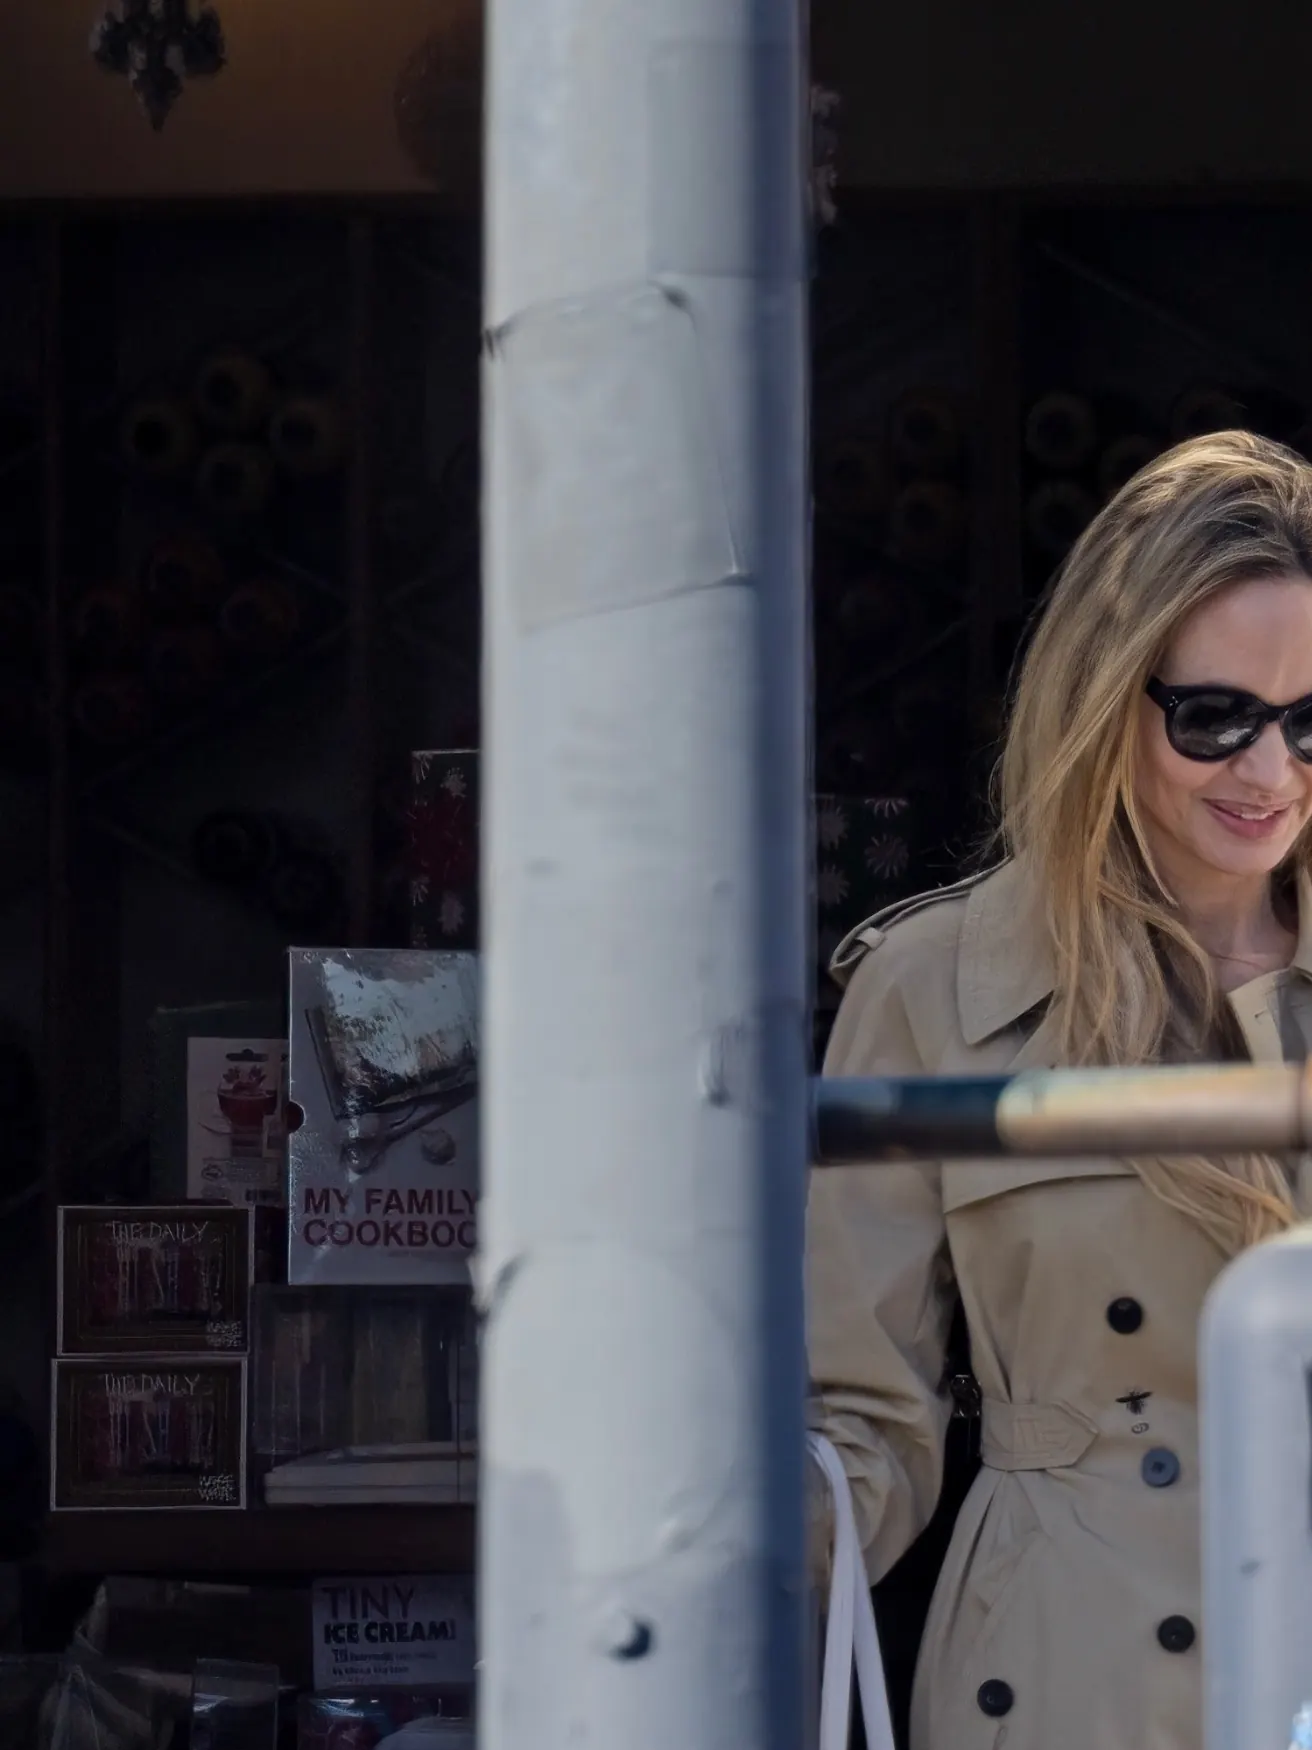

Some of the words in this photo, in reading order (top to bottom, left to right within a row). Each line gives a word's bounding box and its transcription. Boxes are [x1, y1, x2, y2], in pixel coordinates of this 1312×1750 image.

[304, 1187, 352, 1215] MY
[365, 1187, 478, 1215] FAMILY
[150, 1220, 210, 1243] DAILY
[142, 1373, 201, 1396] DAILY
[321, 1582, 415, 1620] TINY
[324, 1622, 360, 1644] ICE
